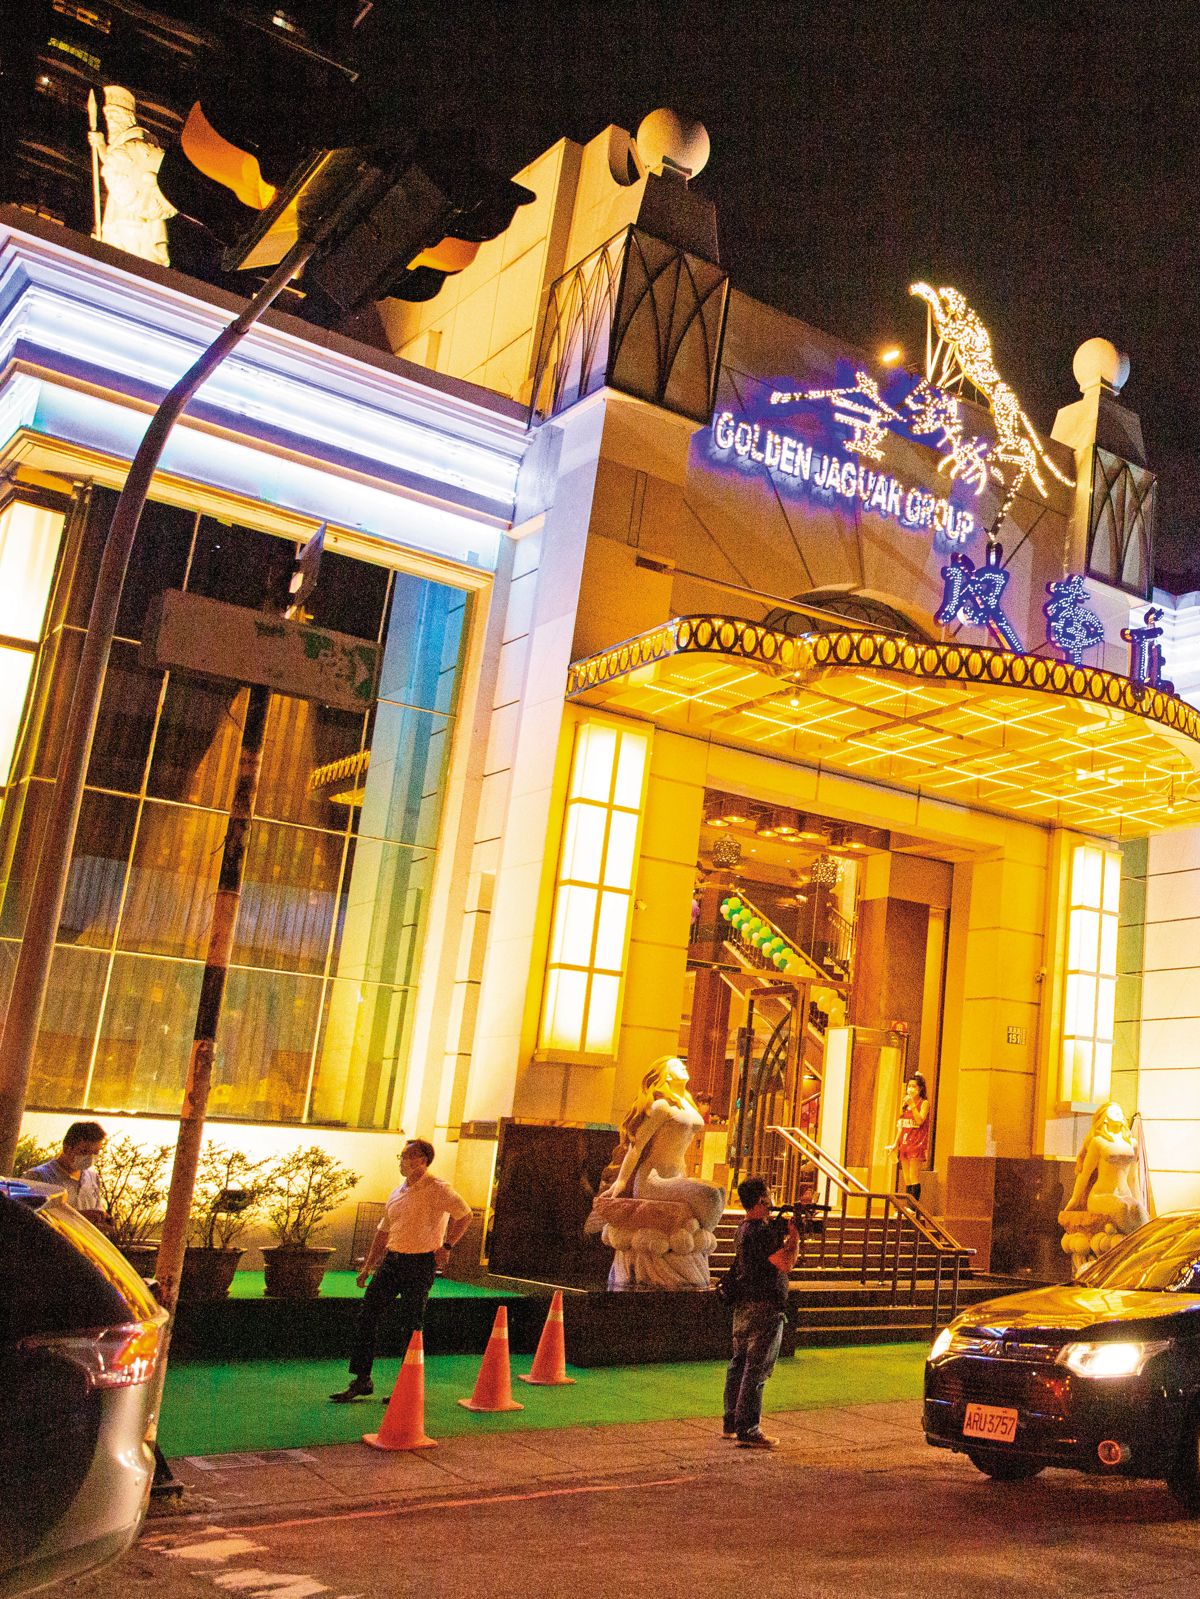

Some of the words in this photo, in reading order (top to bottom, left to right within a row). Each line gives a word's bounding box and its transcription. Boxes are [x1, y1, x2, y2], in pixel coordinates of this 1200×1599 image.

[715, 411, 812, 480] GOLDEN
[814, 453, 903, 516] JAGUAR
[905, 487, 974, 543] GROUP
